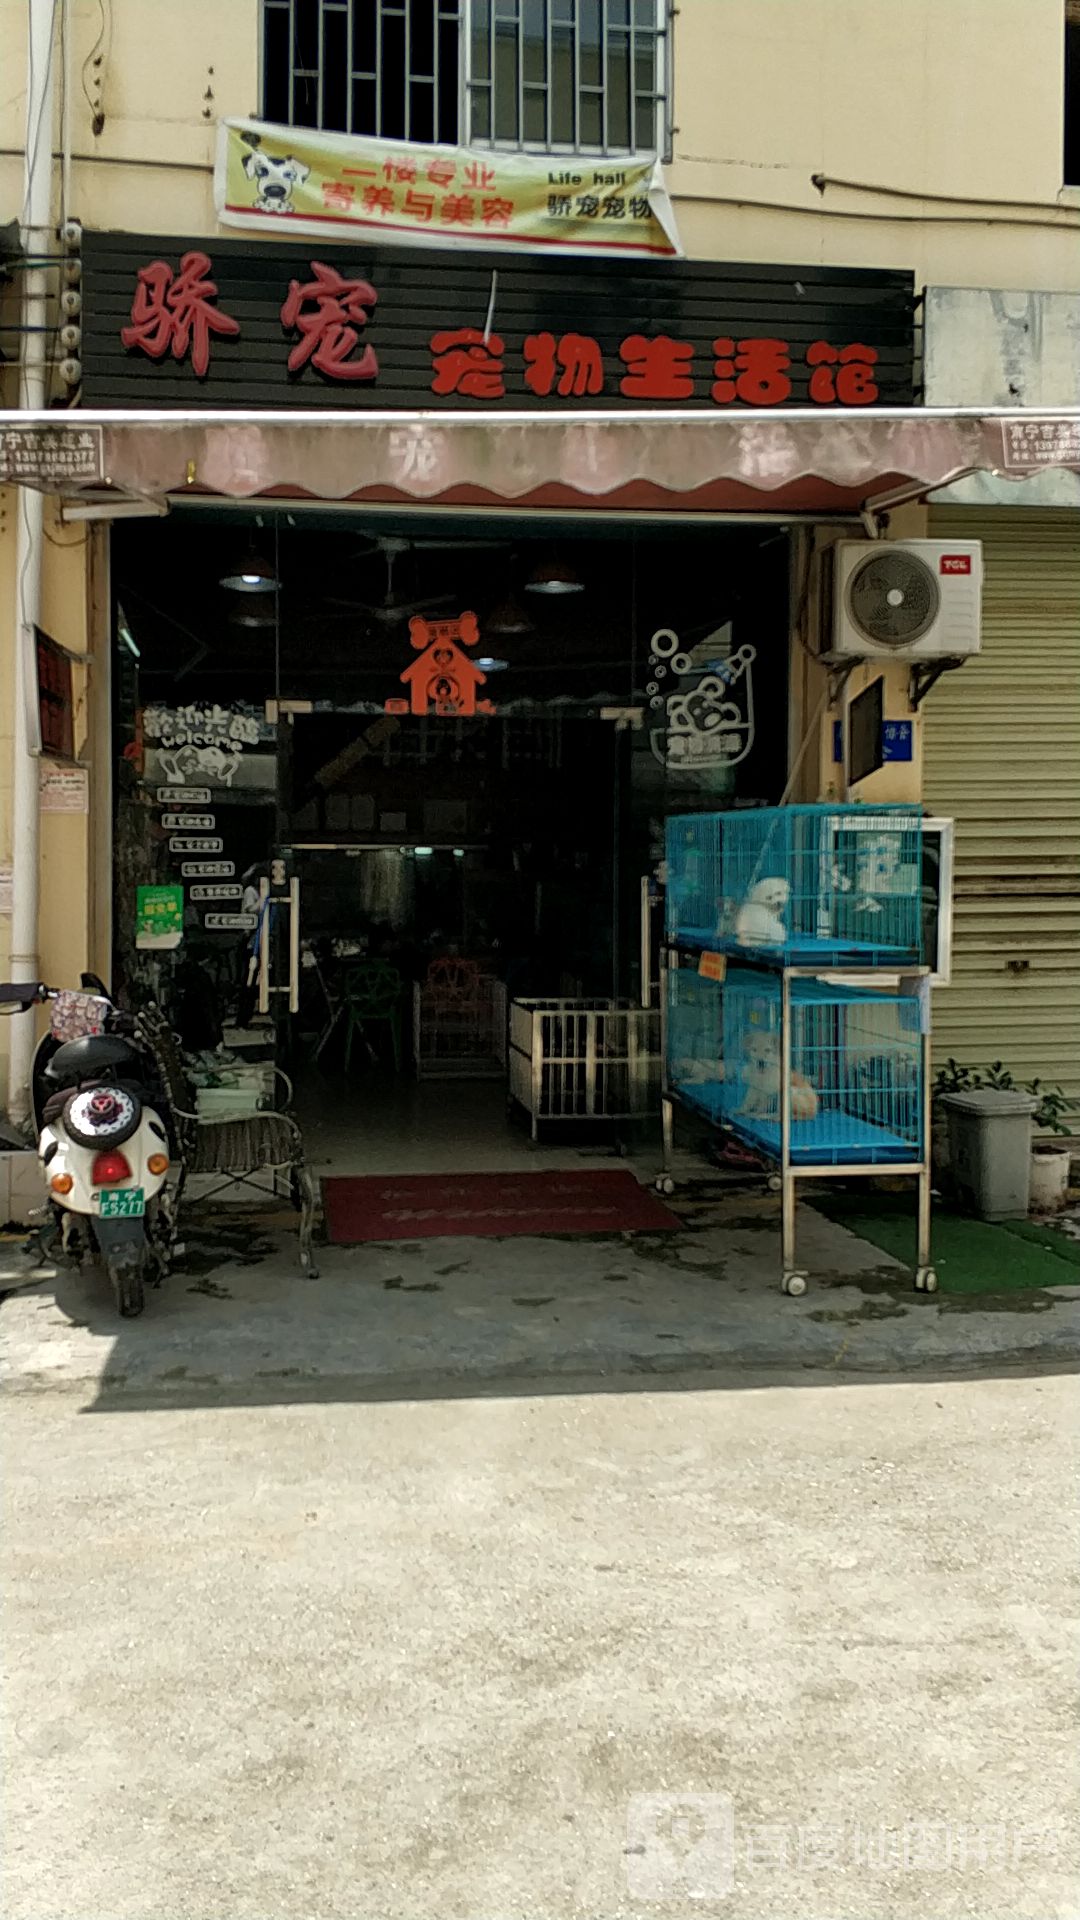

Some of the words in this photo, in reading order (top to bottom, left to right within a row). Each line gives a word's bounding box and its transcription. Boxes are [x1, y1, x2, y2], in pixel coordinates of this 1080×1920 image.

[341, 156, 497, 192] 一楼专业
[548, 171, 581, 186] Life
[593, 172, 626, 187] hall
[321, 181, 515, 229] 寄养与美容
[547, 193, 653, 220] 骄宠宠物
[121, 250, 379, 380] 骄宠
[429, 327, 880, 405] 宠物生活馆
[943, 560, 968, 570] TCL
[161, 730, 243, 751] welcome
